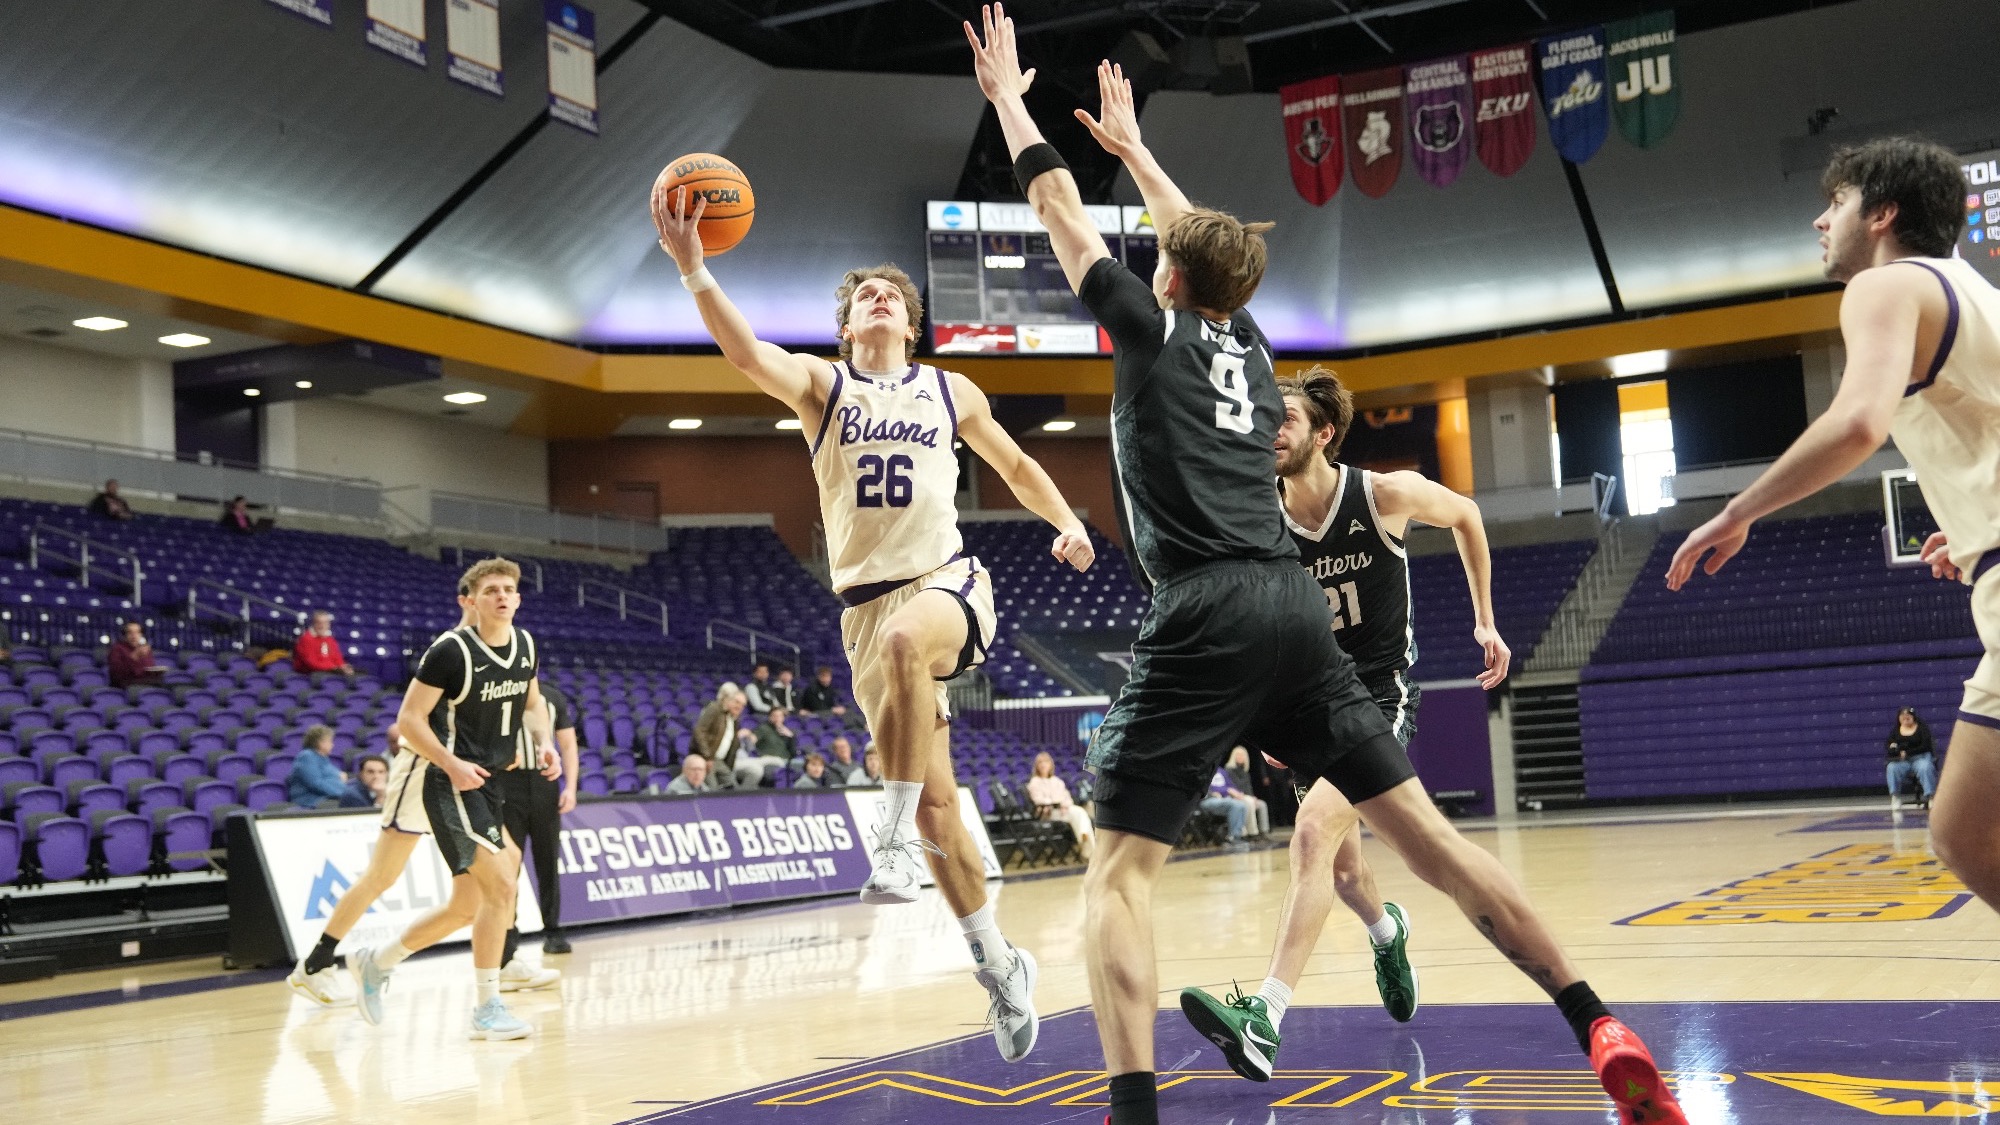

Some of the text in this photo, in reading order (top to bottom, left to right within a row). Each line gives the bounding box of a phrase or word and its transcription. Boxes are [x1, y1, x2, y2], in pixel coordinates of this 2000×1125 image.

[1542, 45, 1603, 69] GULF COAST
[1548, 35, 1595, 55] FLORIDA
[1609, 30, 1675, 56] JACKSONVILLE
[1410, 61, 1459, 80] CENTRAL
[1473, 61, 1530, 82] KENTUCKY
[1474, 49, 1525, 68] EASTERN
[1616, 54, 1672, 102] JU
[1477, 92, 1531, 121] EKU
[673, 157, 742, 177] Wilson
[692, 188, 741, 204] NCAA
[1209, 352, 1254, 434] 9
[837, 405, 939, 448] Bisons
[857, 454, 914, 508] 26
[1303, 551, 1373, 580] atters
[1323, 581, 1362, 632] 21
[500, 701, 513, 737] 1
[731, 813, 853, 858] BISONS
[587, 857, 837, 902] ALLEN ARENA / NASHVILLE, TN
